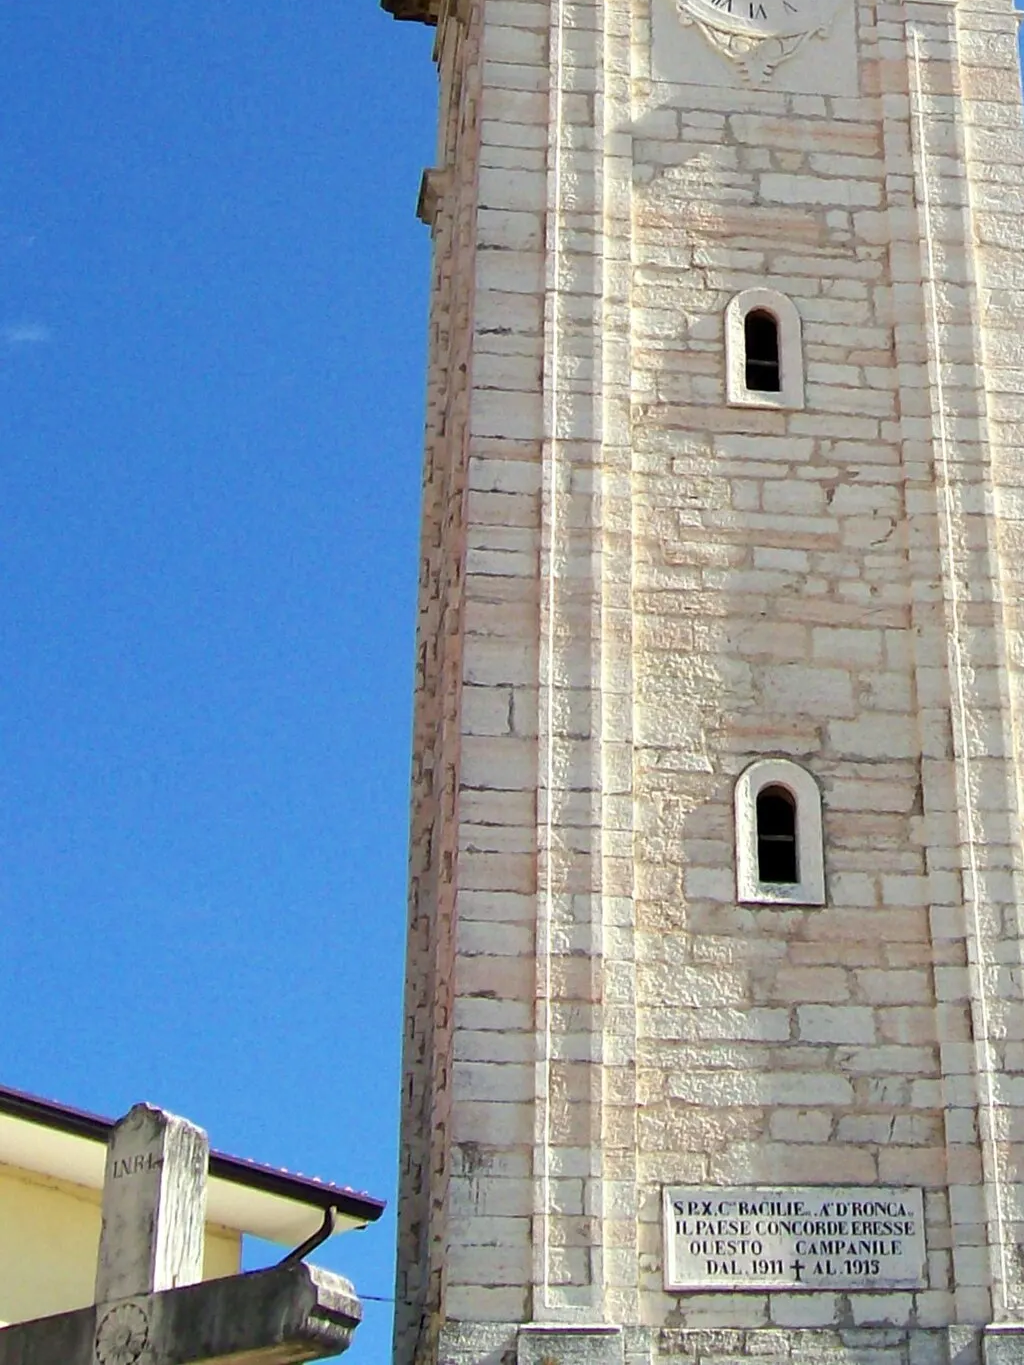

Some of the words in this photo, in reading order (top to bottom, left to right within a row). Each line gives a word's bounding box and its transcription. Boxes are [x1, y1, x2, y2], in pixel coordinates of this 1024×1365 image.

[675, 1220, 693, 1236] IL
[694, 1220, 752, 1236] PAESE
[755, 1220, 849, 1236] CONCORDE
[851, 1220, 916, 1236] ERESSE
[795, 1239, 902, 1255] CAMPANILE
